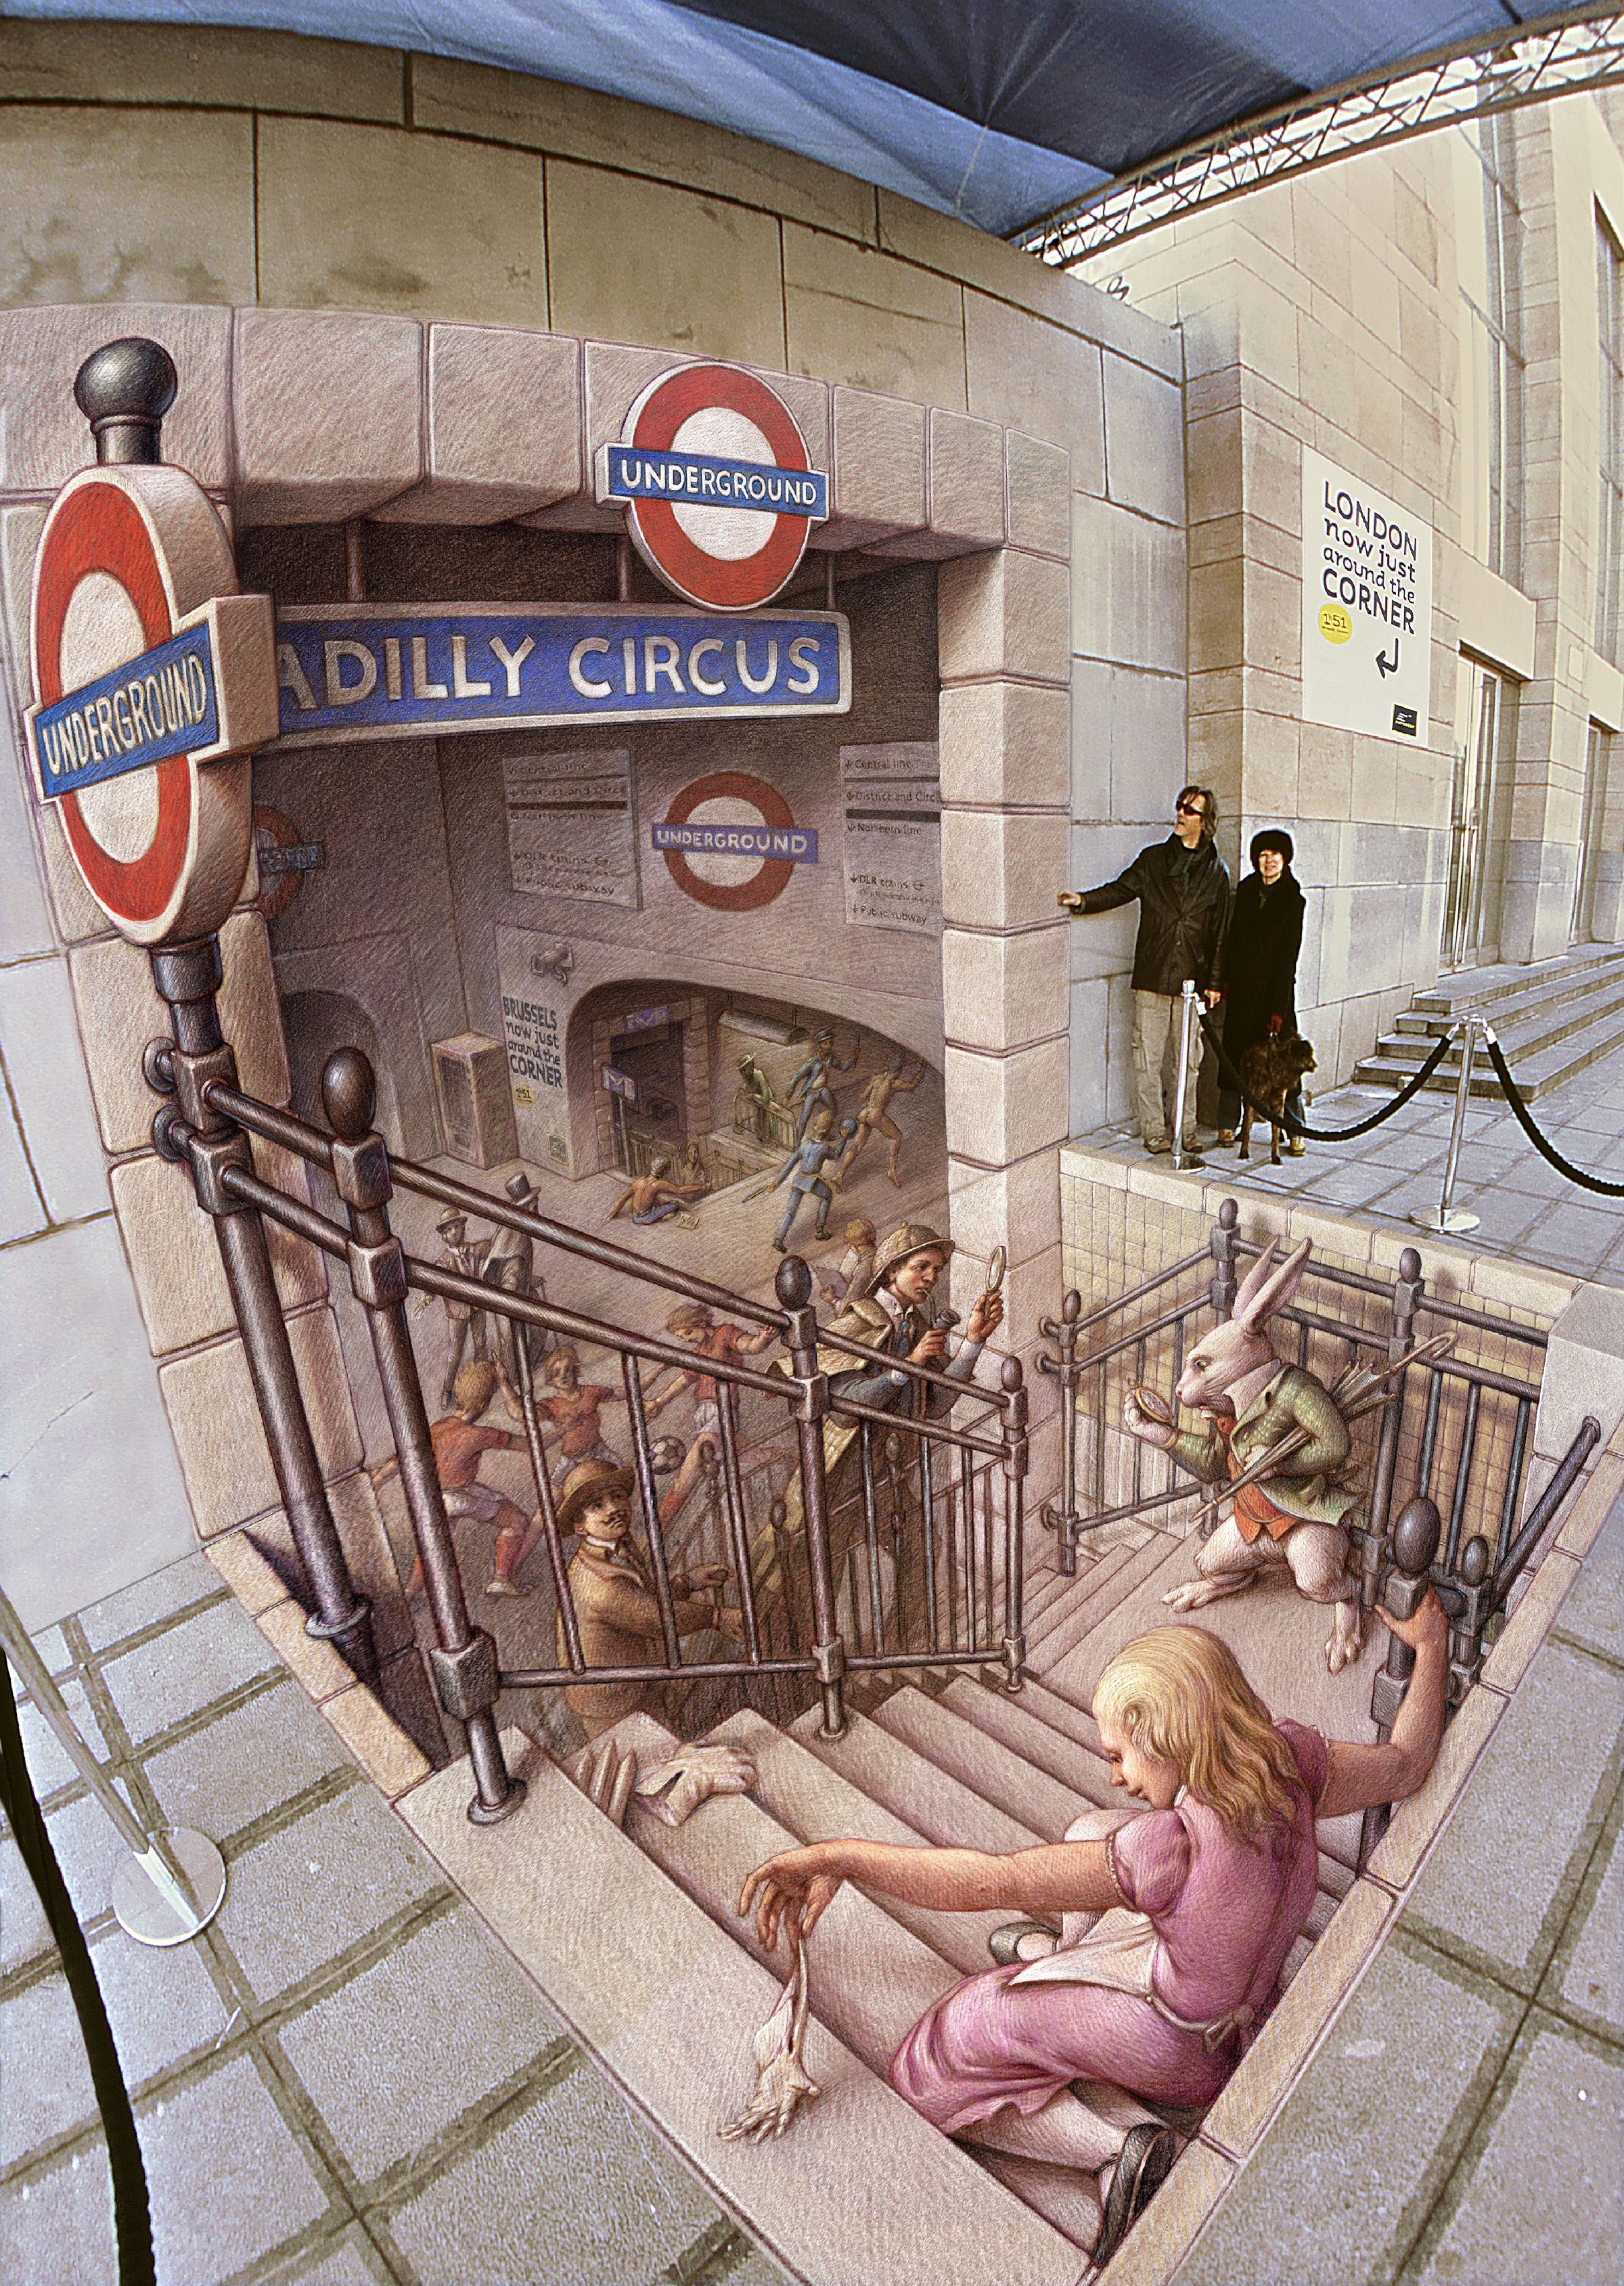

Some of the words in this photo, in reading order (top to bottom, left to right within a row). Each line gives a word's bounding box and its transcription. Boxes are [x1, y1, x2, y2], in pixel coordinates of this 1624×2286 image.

[621, 459, 817, 507] UNDERGROUND
[1324, 480, 1416, 561] LONDON
[1324, 518, 1373, 557] now
[1378, 544, 1416, 583] just
[1324, 547, 1385, 589] around
[1390, 578, 1415, 604] the
[1323, 568, 1414, 635] CORNER
[568, 636, 821, 698] CIRCUS
[42, 654, 206, 776] UNDERGROUND
[656, 831, 807, 855] UNDERGROUND
[859, 874, 877, 885] DLR
[861, 905, 888, 919] Public
[890, 911, 927, 926] subway
[502, 995, 558, 1031] BRUSSELS
[506, 1021, 532, 1039] now
[534, 1025, 560, 1050] just
[508, 1040, 543, 1060] around
[543, 1048, 561, 1066] the
[510, 1054, 564, 1090] CORNER
